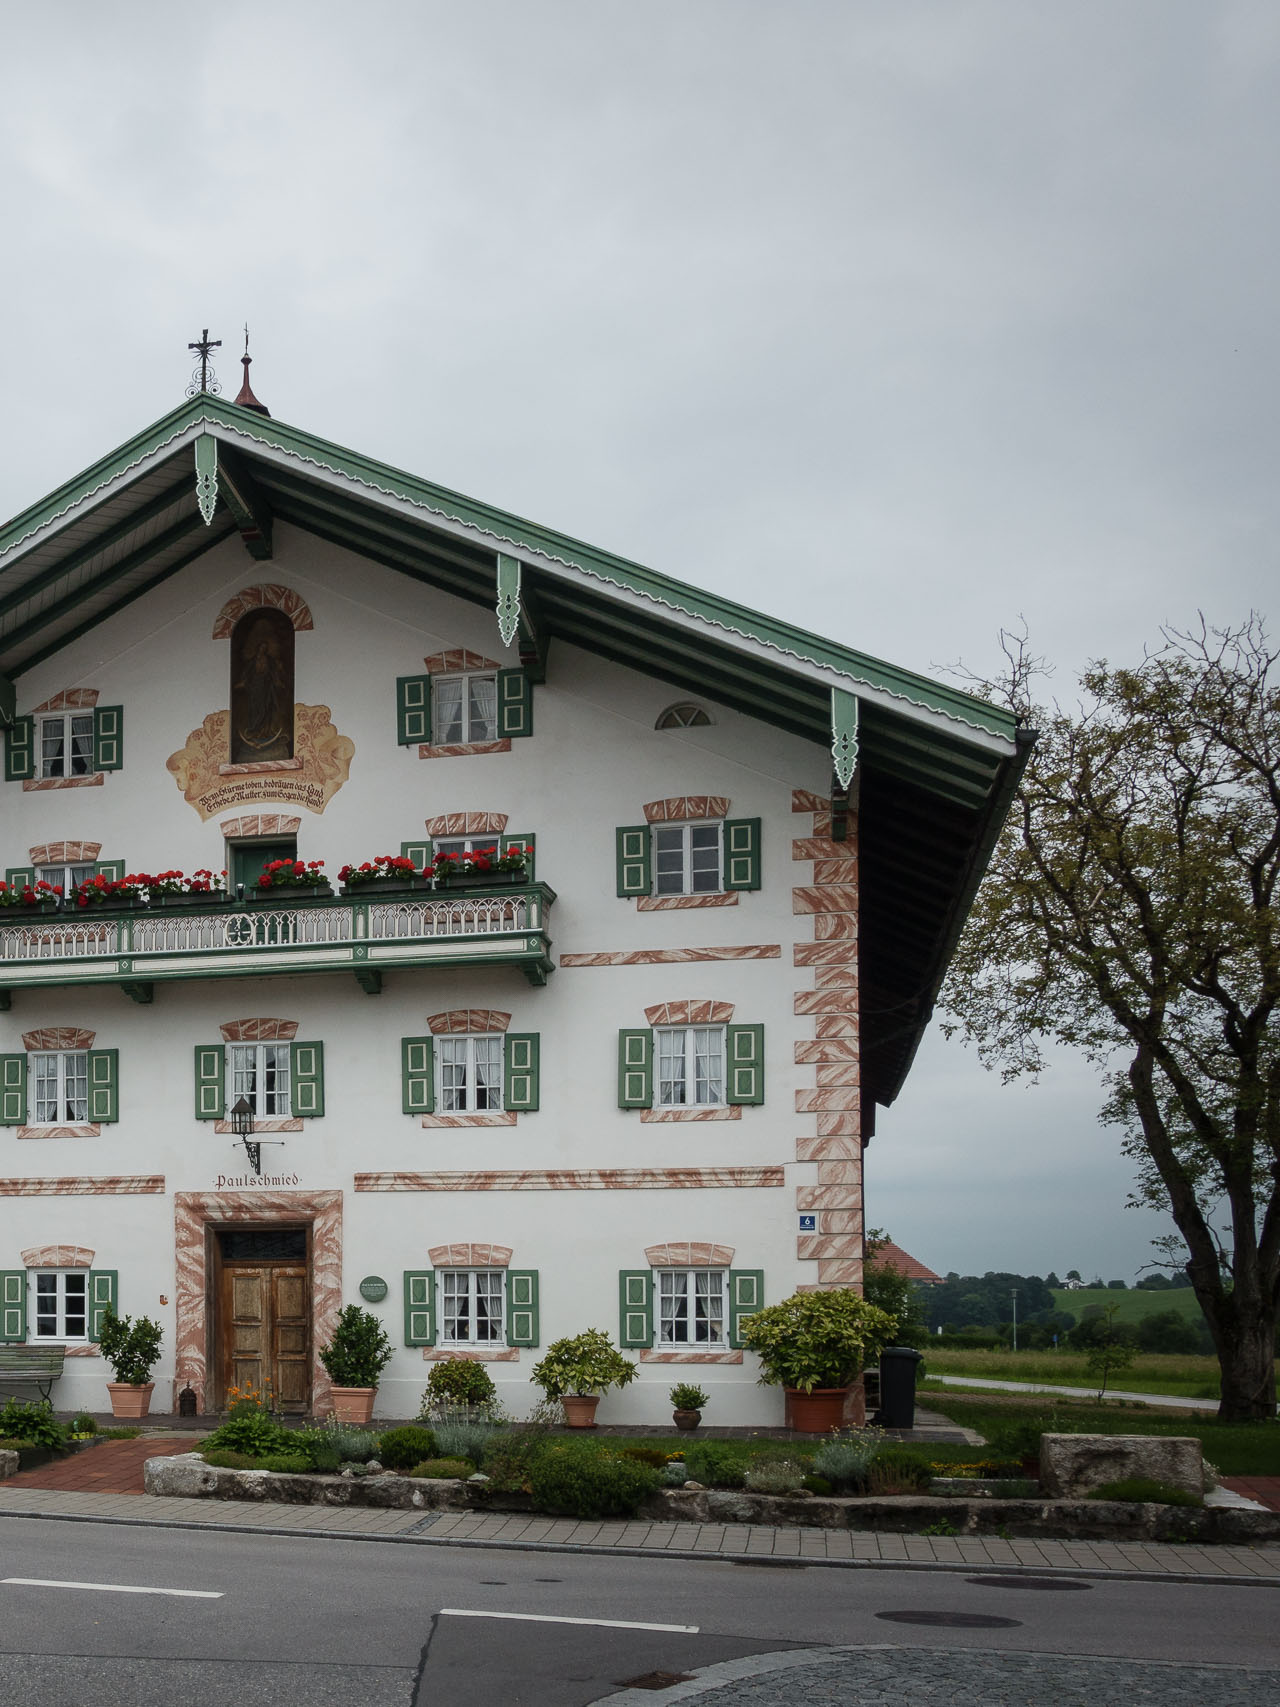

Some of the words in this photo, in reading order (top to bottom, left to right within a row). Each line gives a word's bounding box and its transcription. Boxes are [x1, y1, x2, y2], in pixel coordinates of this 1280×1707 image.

[218, 784, 245, 796] Stürme
[294, 782, 306, 792] das
[261, 790, 277, 800] zum
[278, 789, 296, 802] Segen
[296, 792, 305, 802] die
[804, 1216, 811, 1225] 6
